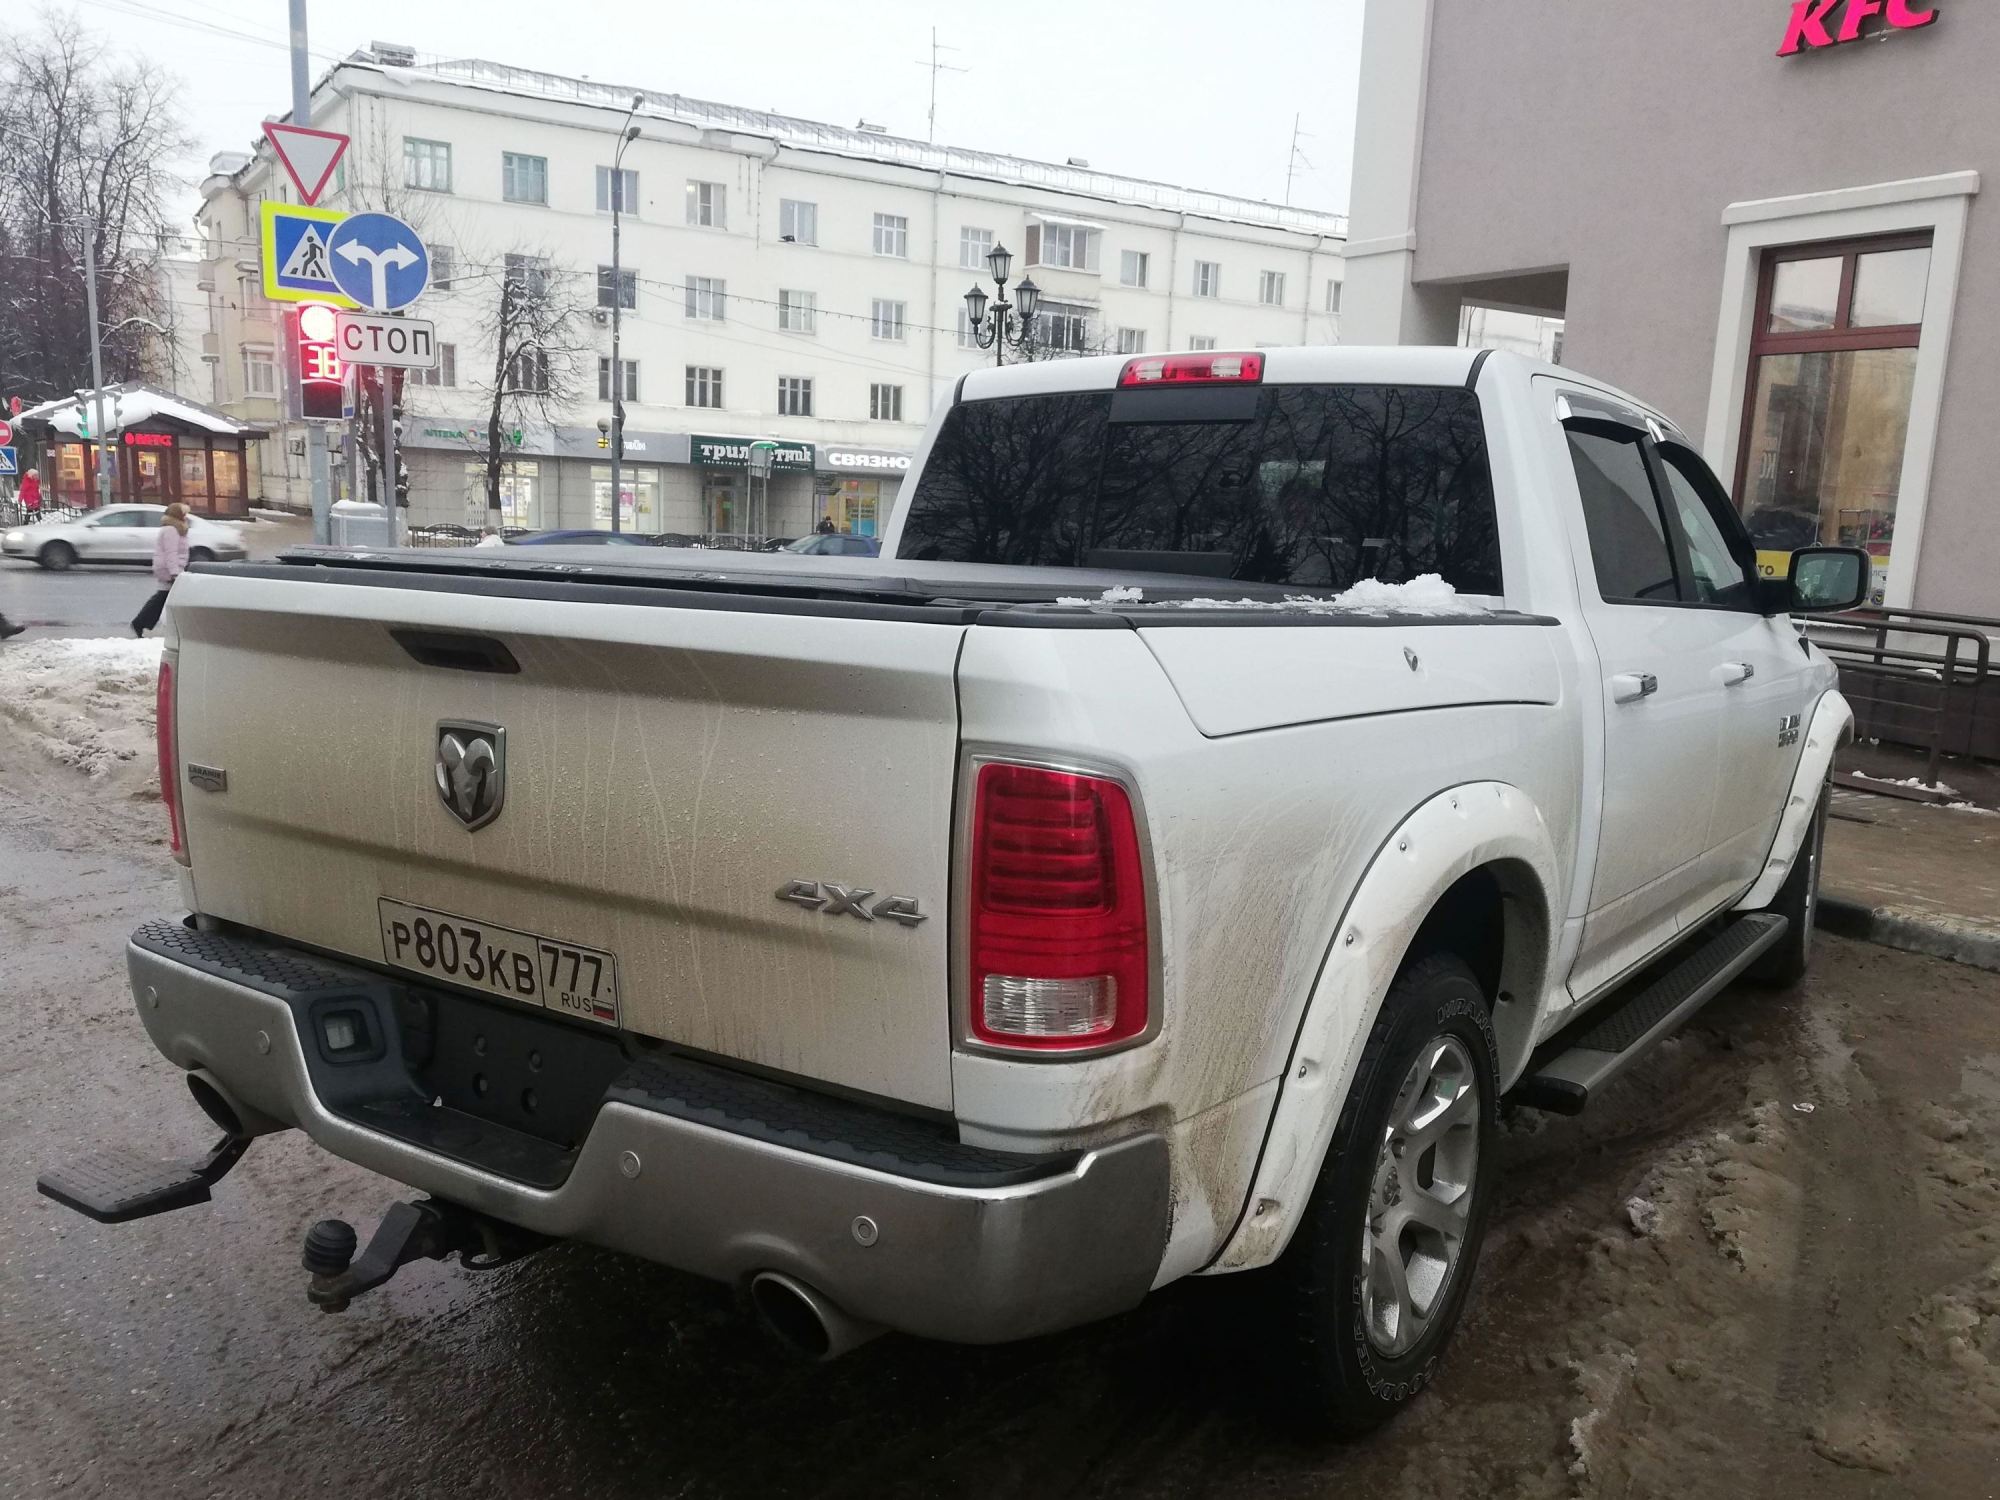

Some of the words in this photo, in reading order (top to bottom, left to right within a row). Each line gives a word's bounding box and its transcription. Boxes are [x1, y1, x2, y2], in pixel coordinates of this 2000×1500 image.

[343, 324, 431, 356] СТОП
[828, 453, 913, 469] СВЯЗНО
[541, 944, 602, 998] 777
[561, 992, 592, 1012] RUS
